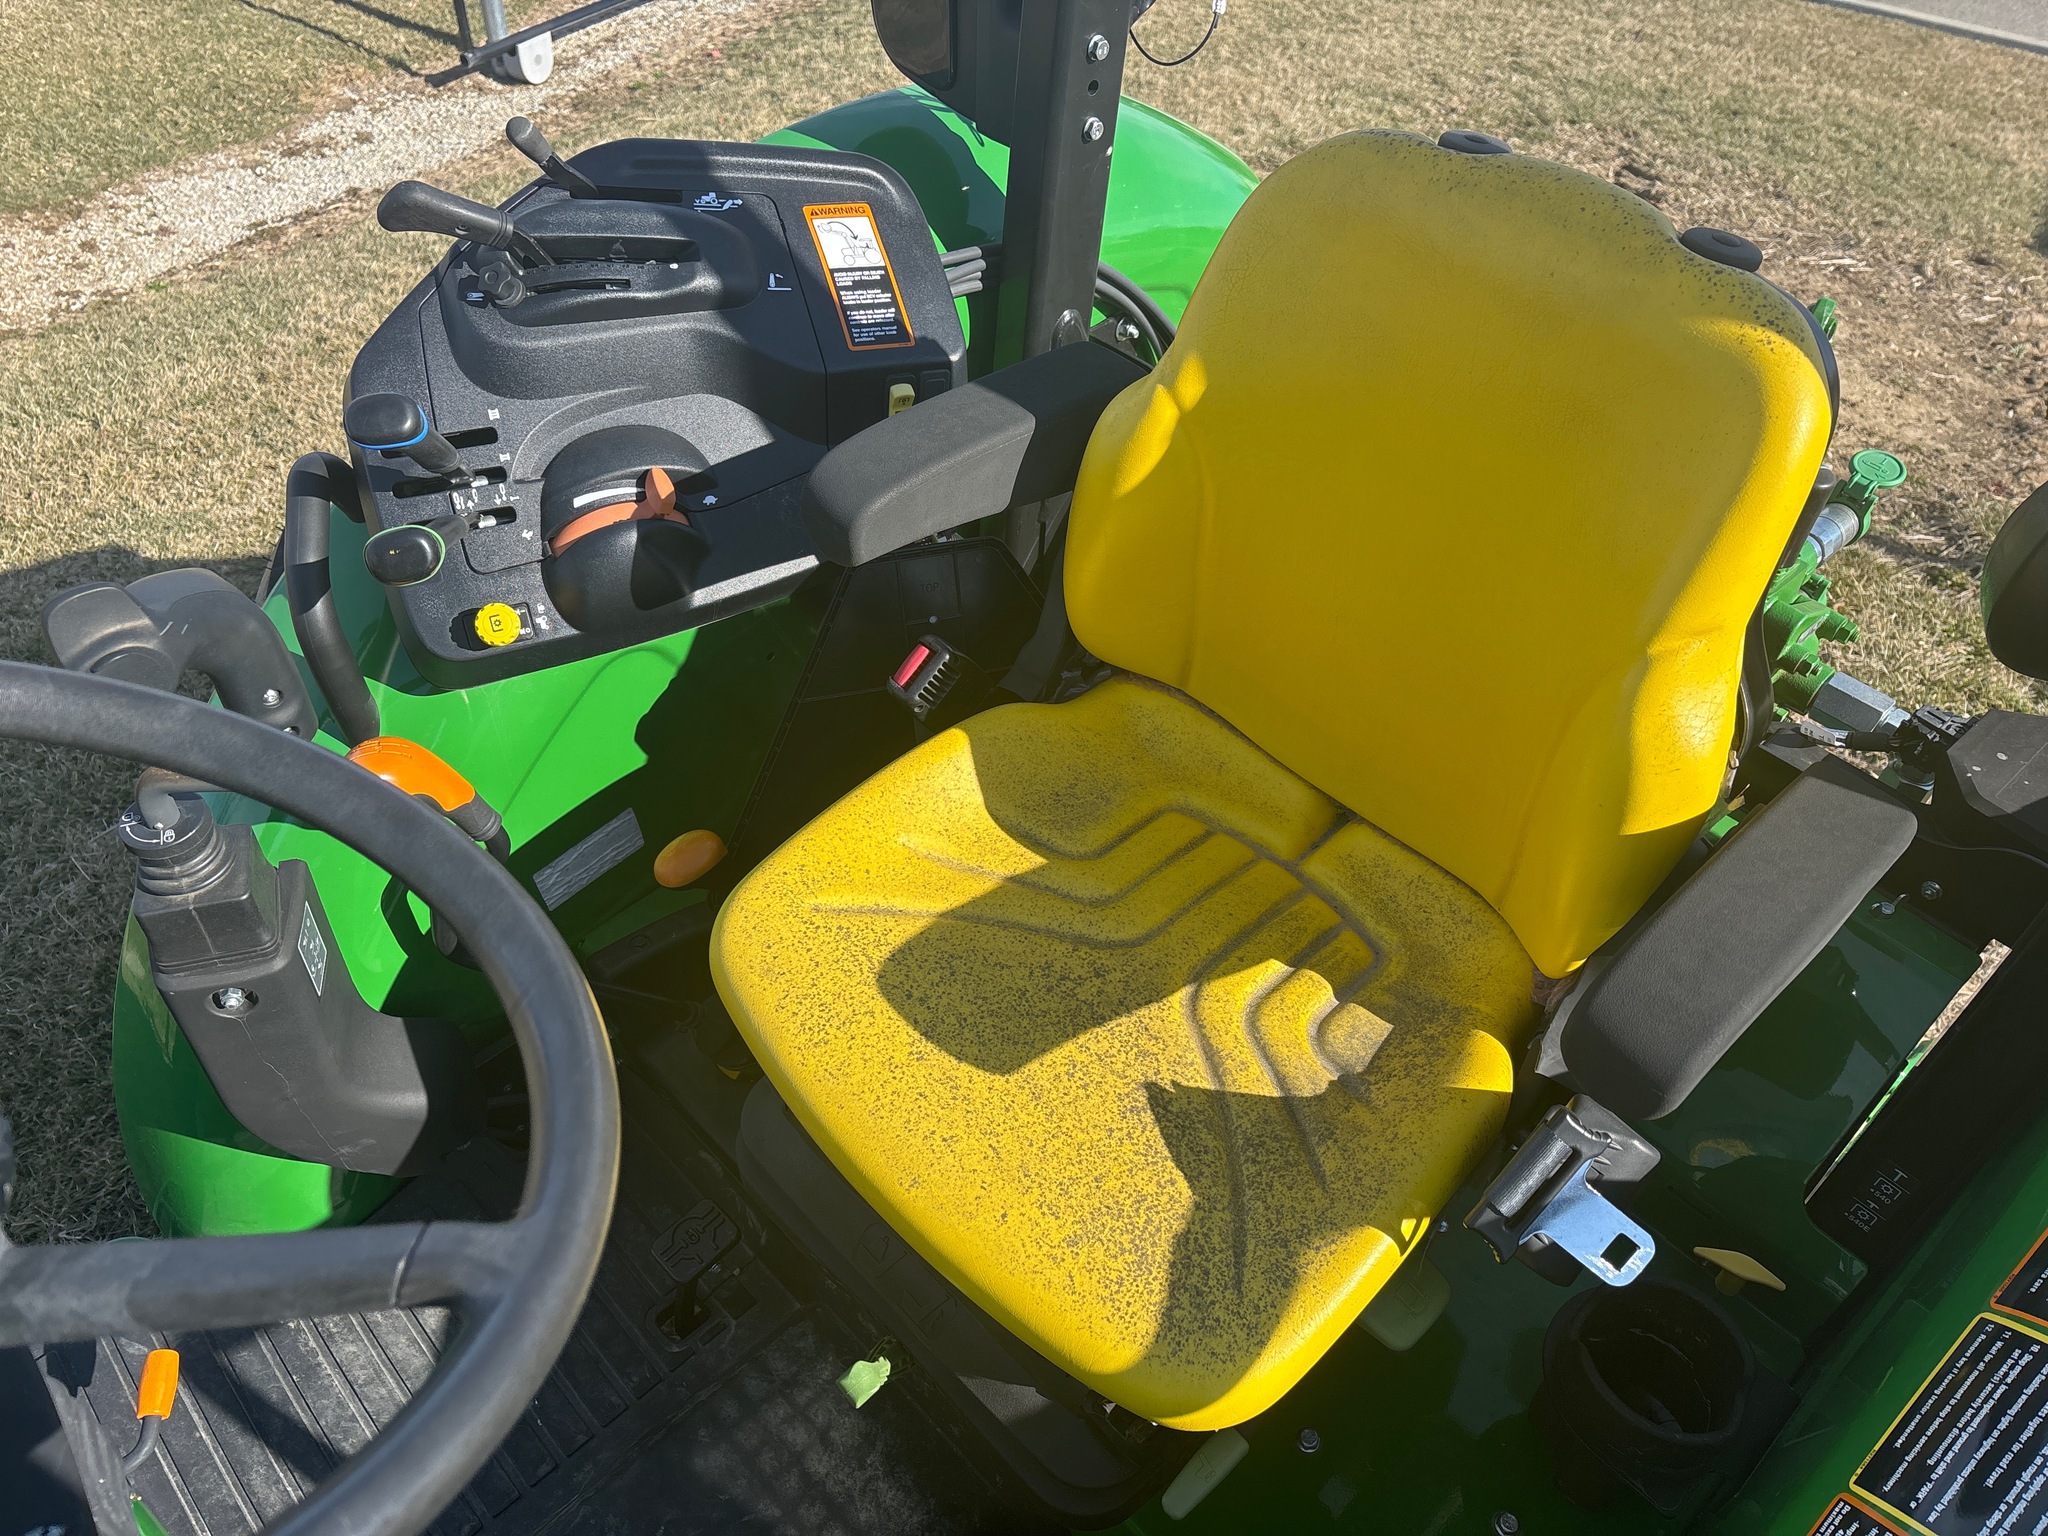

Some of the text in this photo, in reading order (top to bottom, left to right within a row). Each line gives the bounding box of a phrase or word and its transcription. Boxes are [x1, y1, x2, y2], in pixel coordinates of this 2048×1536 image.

[818, 206, 866, 216] WARNING
[920, 582, 939, 593] TOP
[1873, 1190, 1891, 1205] 540
[1847, 1214, 1871, 1233] 540E
[2027, 1278, 2043, 1293] care.
[1983, 1323, 1994, 1332] 12.
[2000, 1330, 2012, 1339] 11.
[1964, 1333, 1986, 1357] Remove
[1989, 1340, 2004, 1355] Wait
[2028, 1344, 2040, 1352] 10.
[1955, 1356, 1968, 1368] key
[1976, 1361, 1986, 1371] all
[1983, 1353, 1993, 1363] for
[2018, 1353, 2033, 1366] Stop
[1933, 1373, 1955, 1395] leaving
[1953, 1369, 1979, 1399] movement
[2002, 1365, 2022, 1384] engine,
[2022, 1373, 2046, 1395] flashing
[1992, 1383, 2008, 1400] lower
[1919, 1394, 1938, 1415] tractor
[1926, 1348, 2022, 1465] set brake(s) securely before dismounting.
[1939, 1404, 1952, 1418] stop
[1970, 1398, 1997, 1428] implement
[2006, 1393, 2028, 1416] warning
[1893, 1414, 1922, 1448] unattended.
[1925, 1417, 1943, 1436] before
[1996, 1414, 2014, 1431] lights
[2018, 1416, 2043, 1443] together
[1951, 1431, 1969, 1453] ground
[1990, 1429, 2000, 1438] on
[1904, 1435, 1928, 1462] servicing
[1943, 1450, 1955, 1463] and
[1972, 1436, 1996, 1460] highway
[2011, 1441, 2023, 1453] for
[1934, 1460, 1947, 1475] shift
[1960, 1458, 1978, 1478] unless
[1998, 1451, 2014, 1469] road
[2033, 1455, 2044, 1466] on
[1882, 1461, 1908, 1492] machinery.
[1983, 1466, 2004, 1488] travel.
[2020, 1463, 2038, 1482] rough
[1940, 1474, 1964, 1506] prohibited
[2003, 1479, 2025, 1504] ground,
[2022, 1474, 2046, 1501] applying
[1841, 1504, 1851, 1515] Do
[1926, 1510, 1940, 1523] law.
[1934, 1502, 1946, 1512] by
[2001, 1499, 2029, 1531] individual
[1819, 1501, 1844, 1533] maximum
[1832, 1513, 1843, 1526] not
[1985, 1509, 2002, 1528] steep
